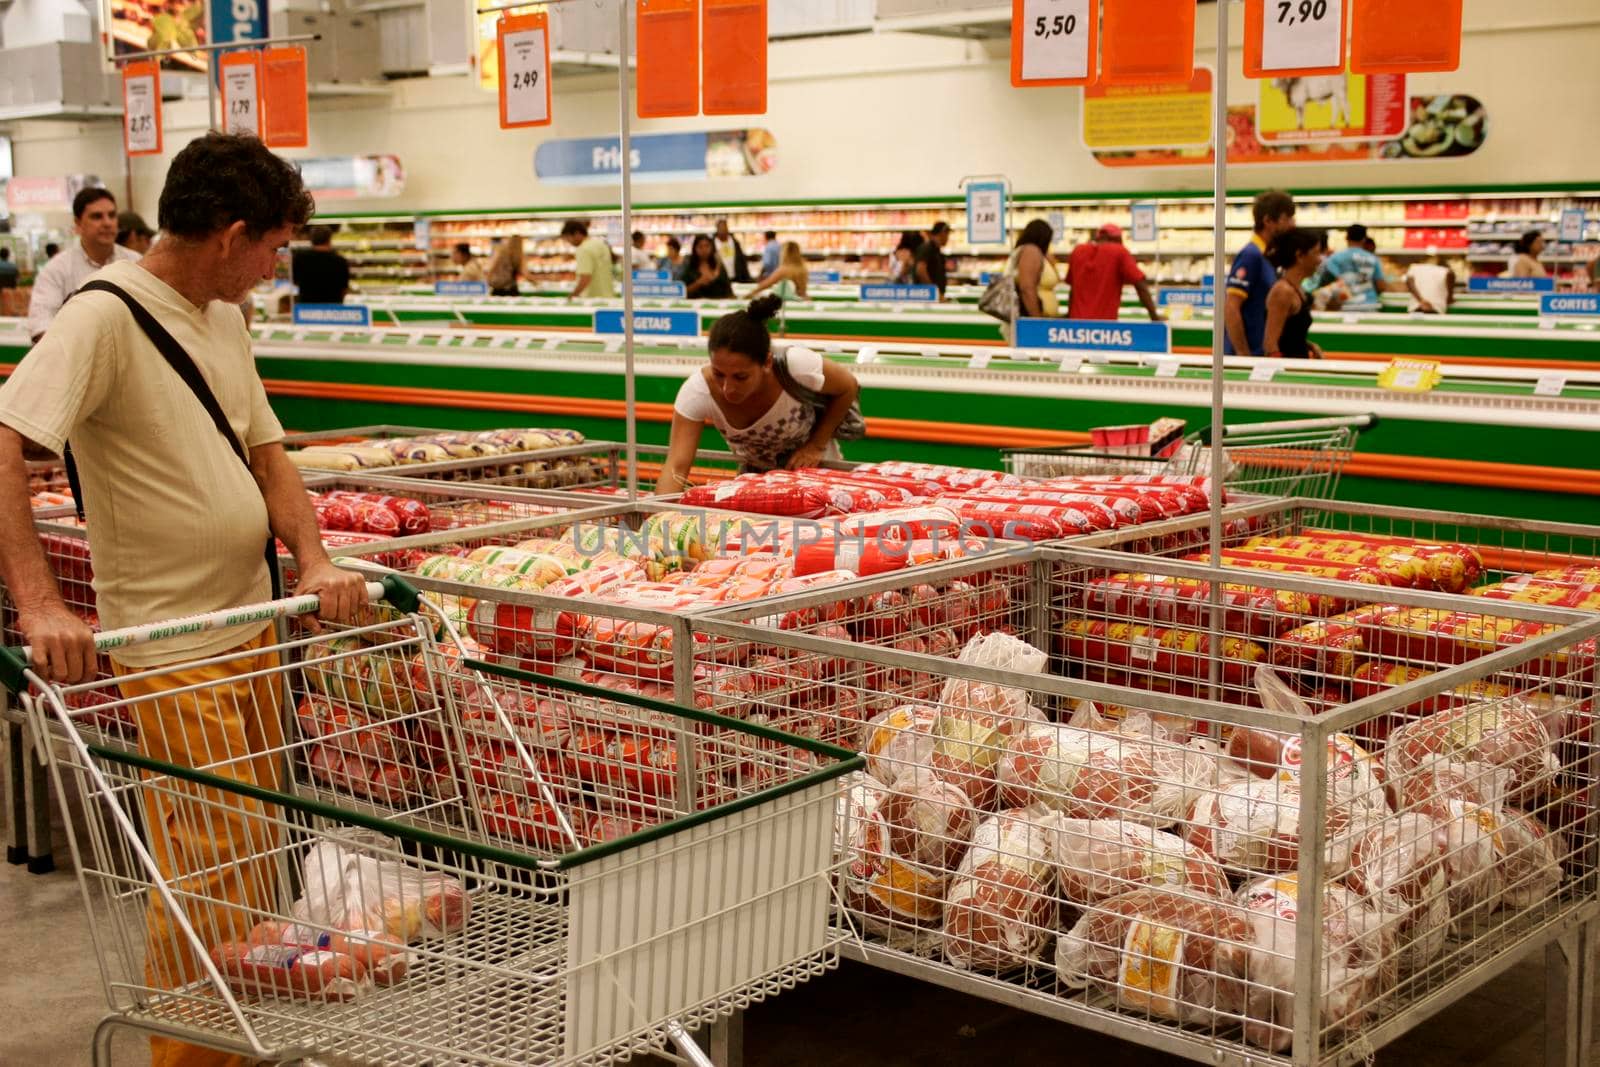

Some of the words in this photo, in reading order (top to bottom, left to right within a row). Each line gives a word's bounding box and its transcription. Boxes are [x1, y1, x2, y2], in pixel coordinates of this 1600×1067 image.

[1277, 0, 1327, 26] 7,90
[1034, 15, 1076, 39] 5,50
[513, 70, 538, 90] 2,49
[592, 146, 640, 169] Fris
[1550, 298, 1598, 311] CORTES
[620, 316, 672, 331] VGETAIS
[1048, 327, 1133, 345] SALSICHAS
